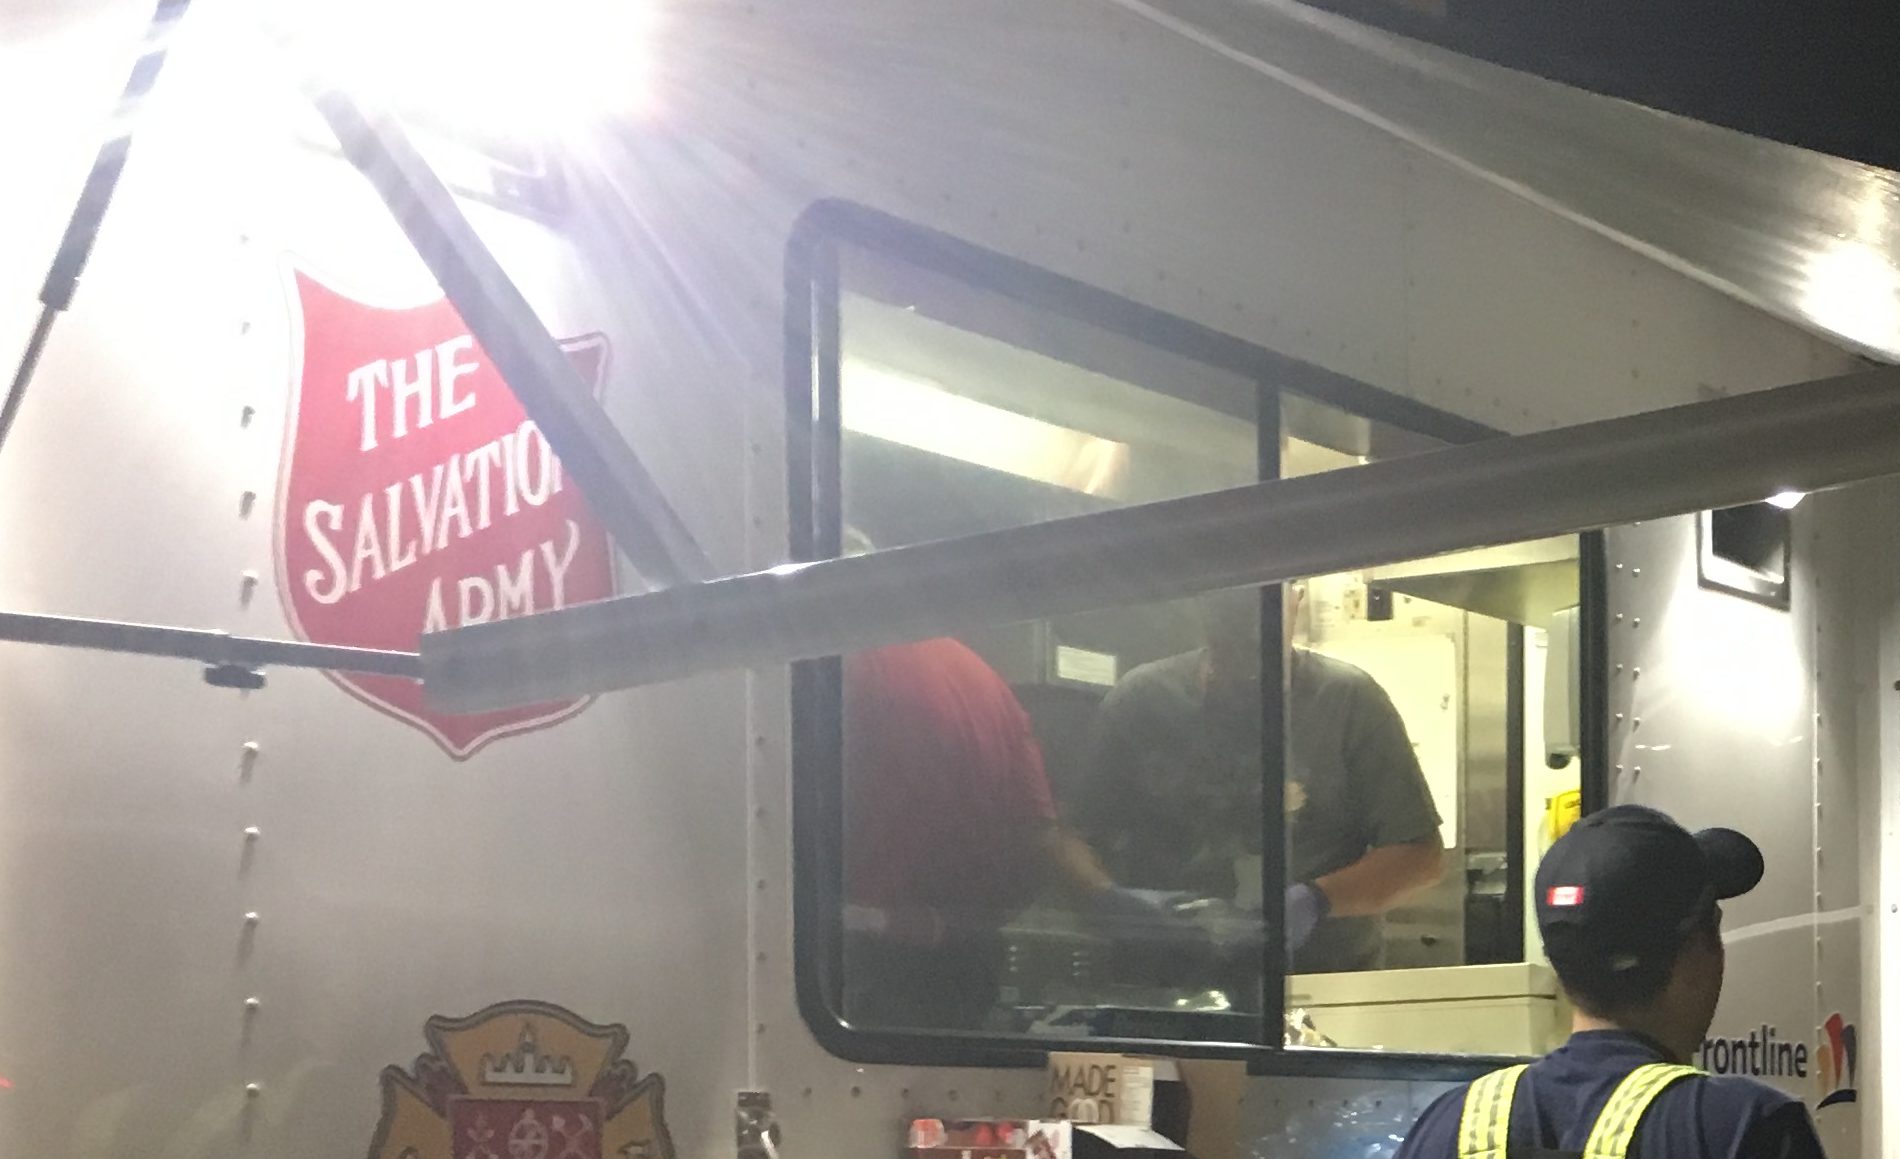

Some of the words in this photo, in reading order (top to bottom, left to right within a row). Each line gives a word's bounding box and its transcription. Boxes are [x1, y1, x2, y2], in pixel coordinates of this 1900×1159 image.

[346, 334, 480, 452] THE
[1701, 1024, 1808, 1079] rontline
[1051, 1063, 1117, 1098] MADE
[1050, 1096, 1115, 1125] GOOD
